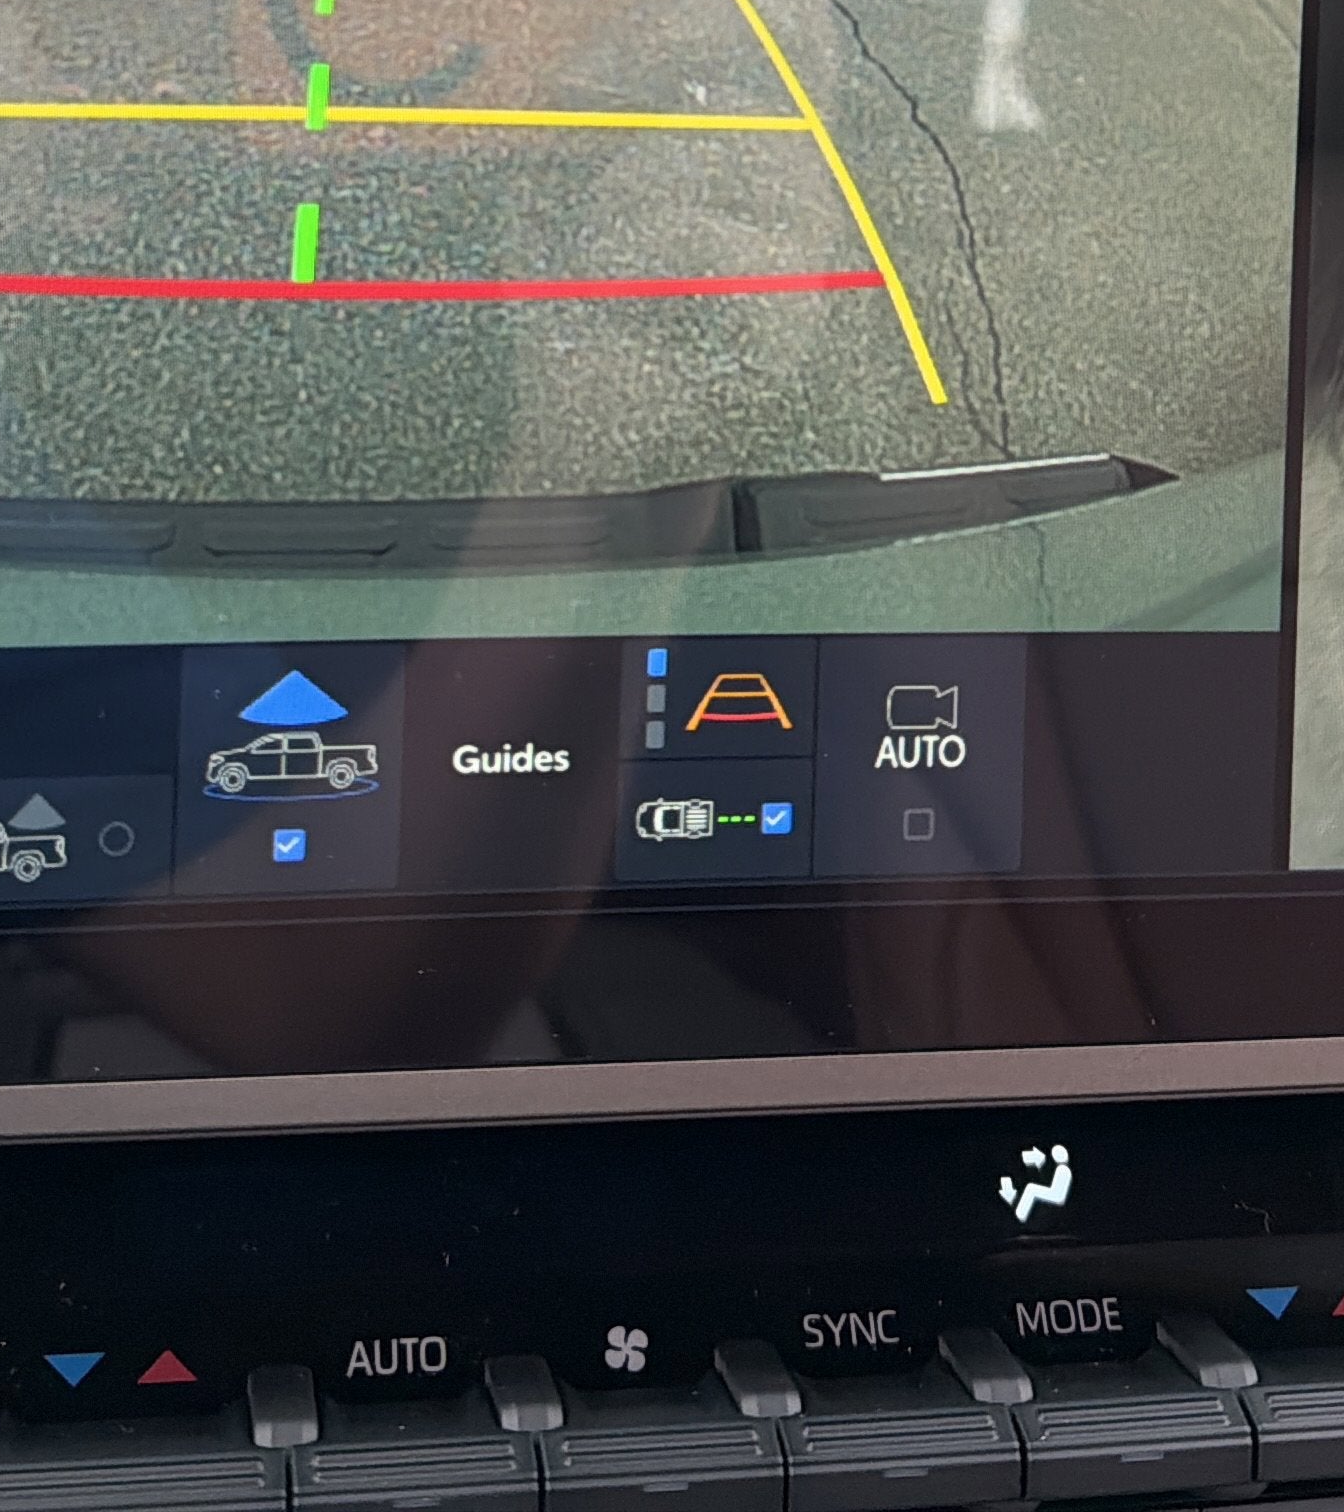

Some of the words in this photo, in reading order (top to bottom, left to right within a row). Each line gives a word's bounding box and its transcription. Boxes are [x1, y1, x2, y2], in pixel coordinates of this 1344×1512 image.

[452, 742, 571, 775] Guides
[874, 734, 967, 770] AUTO
[803, 1309, 901, 1349] SYNC
[1015, 1297, 1124, 1337] MODE
[346, 1336, 448, 1378] AUTO
